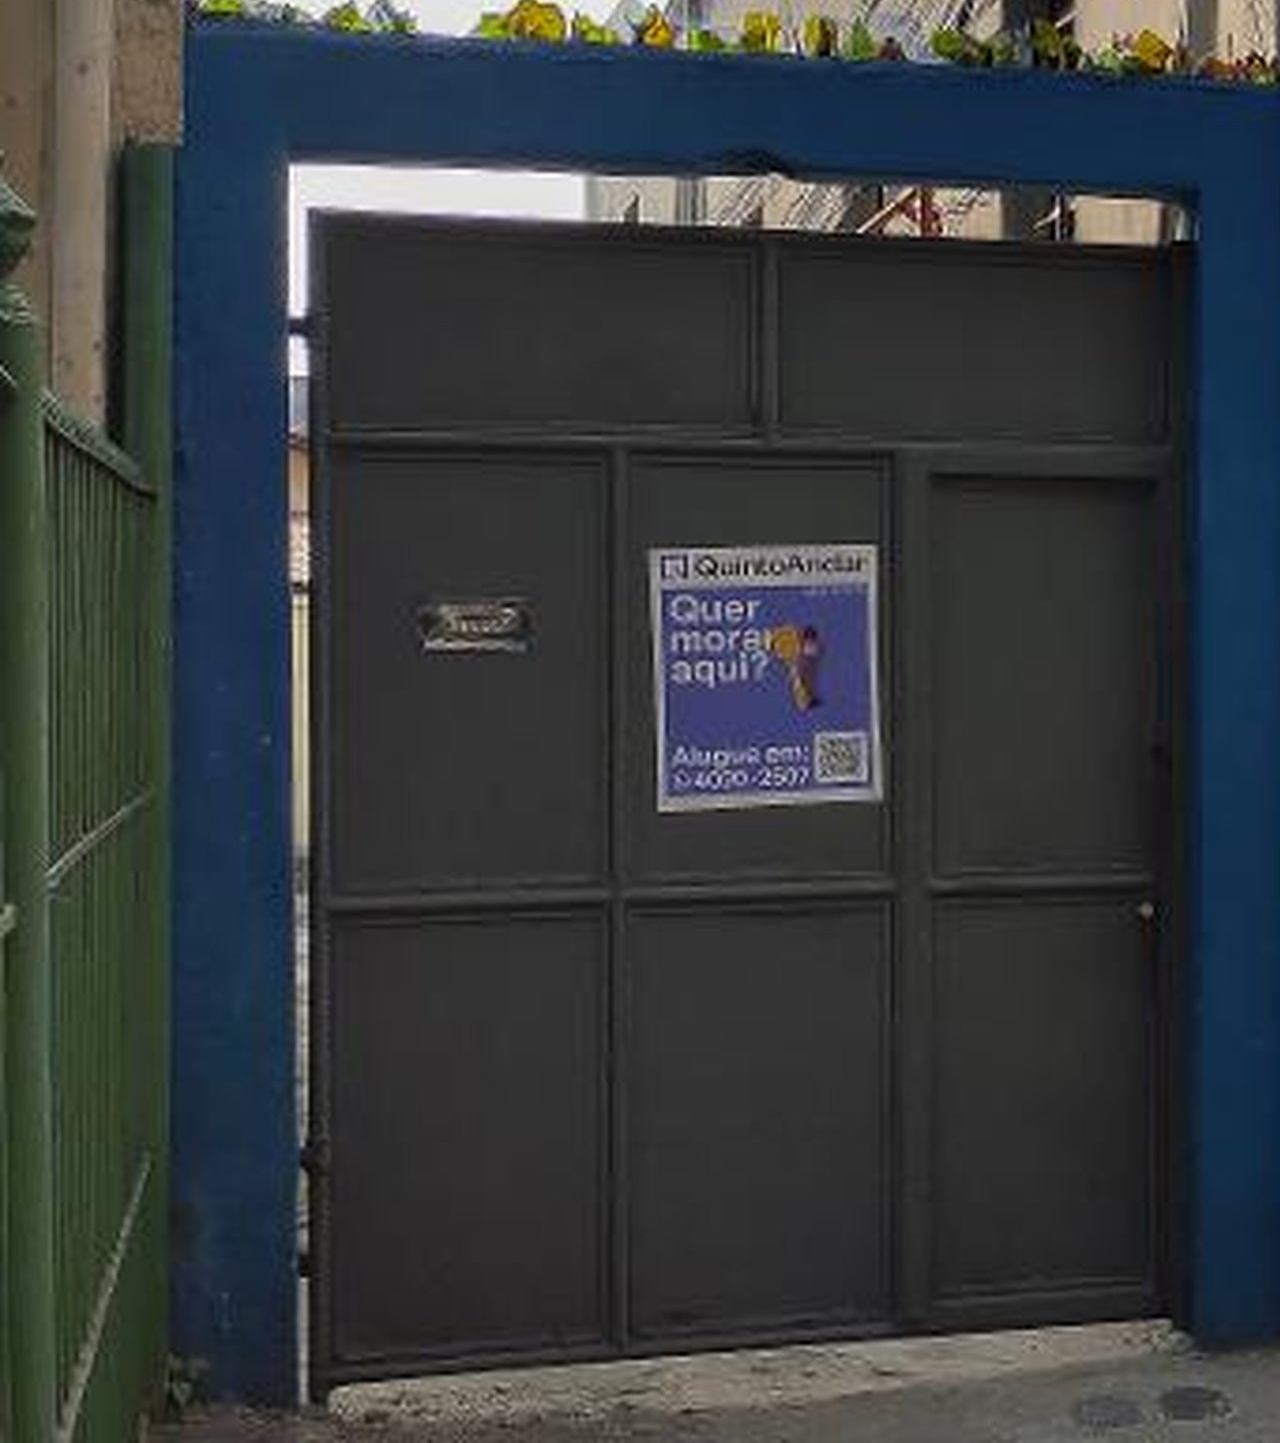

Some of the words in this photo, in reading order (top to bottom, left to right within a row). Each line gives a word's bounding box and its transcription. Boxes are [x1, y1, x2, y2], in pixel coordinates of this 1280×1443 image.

[695, 554, 863, 579] QuintoAndar
[670, 594, 760, 623] Quer
[670, 627, 772, 653] morar
[670, 652, 768, 689] aqui?
[672, 745, 761, 769] Alugue
